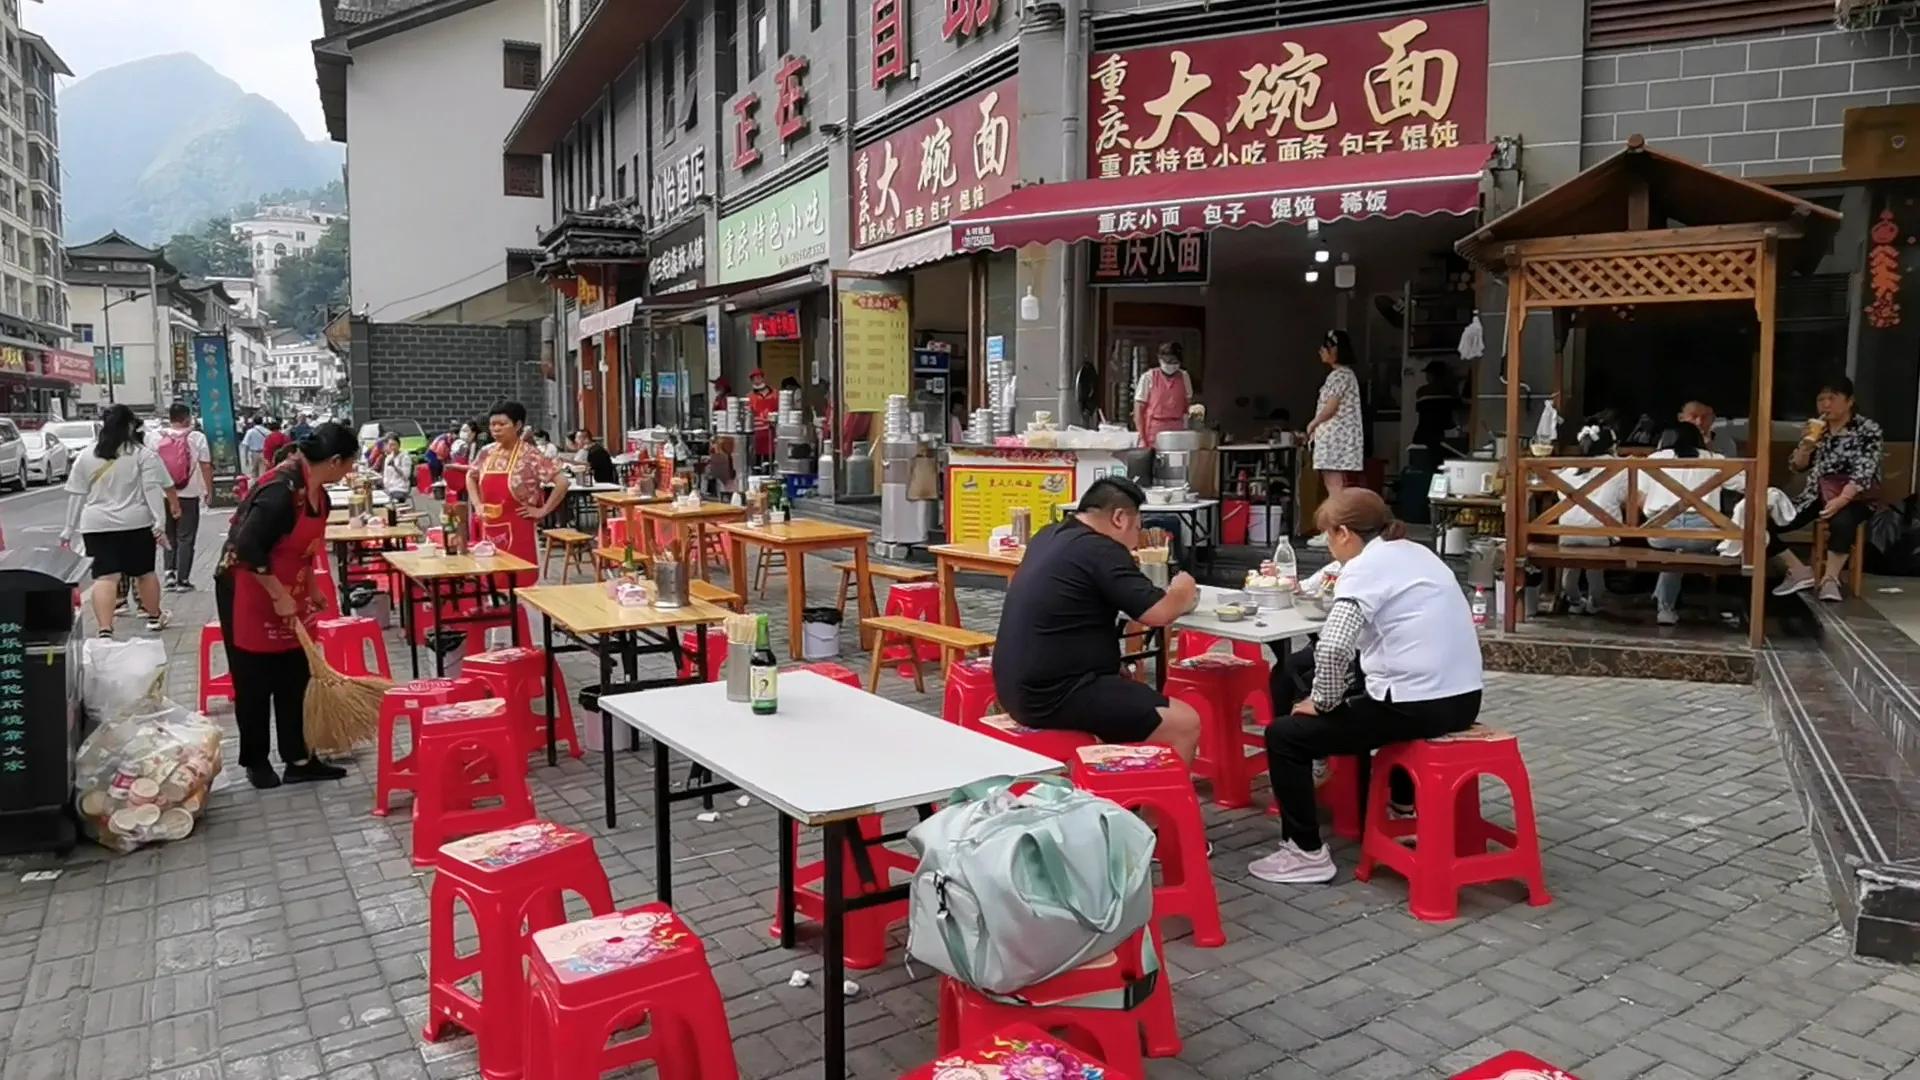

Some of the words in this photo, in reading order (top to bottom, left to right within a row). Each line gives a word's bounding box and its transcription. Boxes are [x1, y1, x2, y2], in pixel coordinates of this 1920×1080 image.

[731, 55, 808, 170] 正在
[1091, 54, 1132, 153] 重庆
[1134, 18, 1460, 150] 大碗面
[874, 91, 1009, 218] 大碗面
[1099, 140, 1267, 178] 重庆特色小吃
[1277, 134, 1328, 162] 面条
[1341, 131, 1394, 157] 包子
[1401, 122, 1460, 151] 馄饨
[857, 152, 871, 226] 重庆
[930, 196, 952, 221] 包子
[1098, 206, 1181, 233] 重庆小面
[1203, 202, 1246, 225] 包子
[1270, 196, 1316, 219] 馄饨
[1340, 190, 1387, 214] 稀饭
[724, 189, 825, 269] 重庆特色小吃
[1096, 232, 1201, 277] 重庆小面
